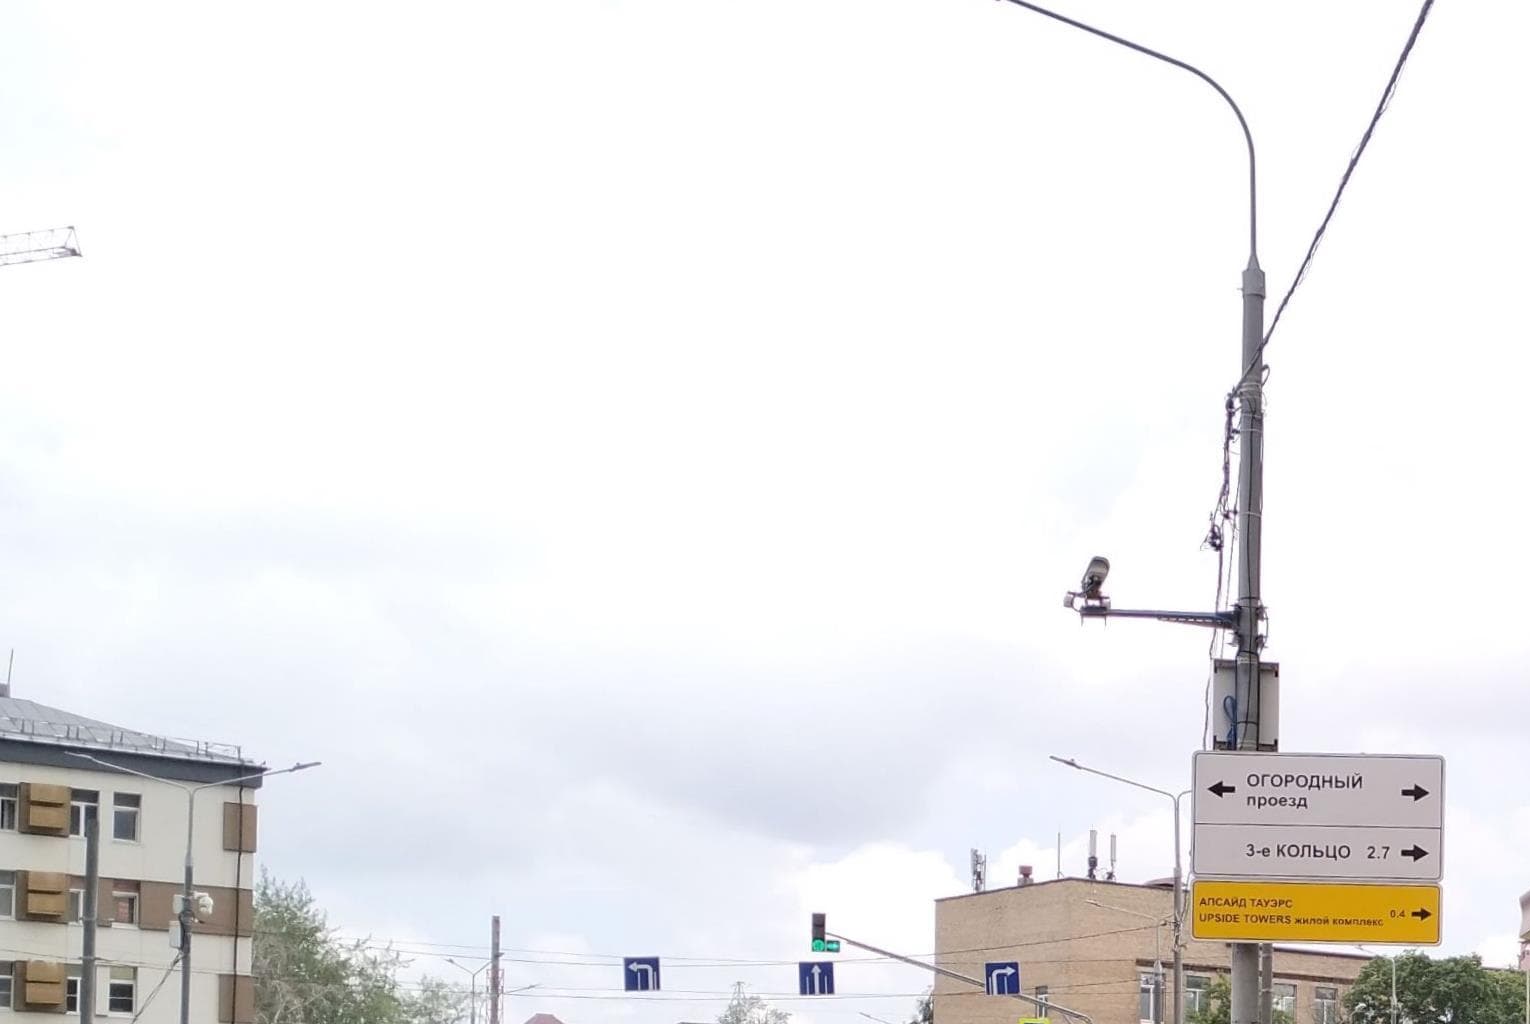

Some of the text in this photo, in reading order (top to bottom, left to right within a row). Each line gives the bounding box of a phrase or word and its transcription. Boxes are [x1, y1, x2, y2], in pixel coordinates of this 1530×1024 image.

[1246, 772, 1363, 791] ОГОРОДНЫЙ
[1246, 795, 1308, 810] проезд
[1245, 843, 1391, 861] 3-е КОЛЬЦО 2.7
[1199, 896, 1293, 909] АПСАЙД ТАУЭРС
[1199, 913, 1385, 928] UPSIDE TOWERS жилой комплекс
